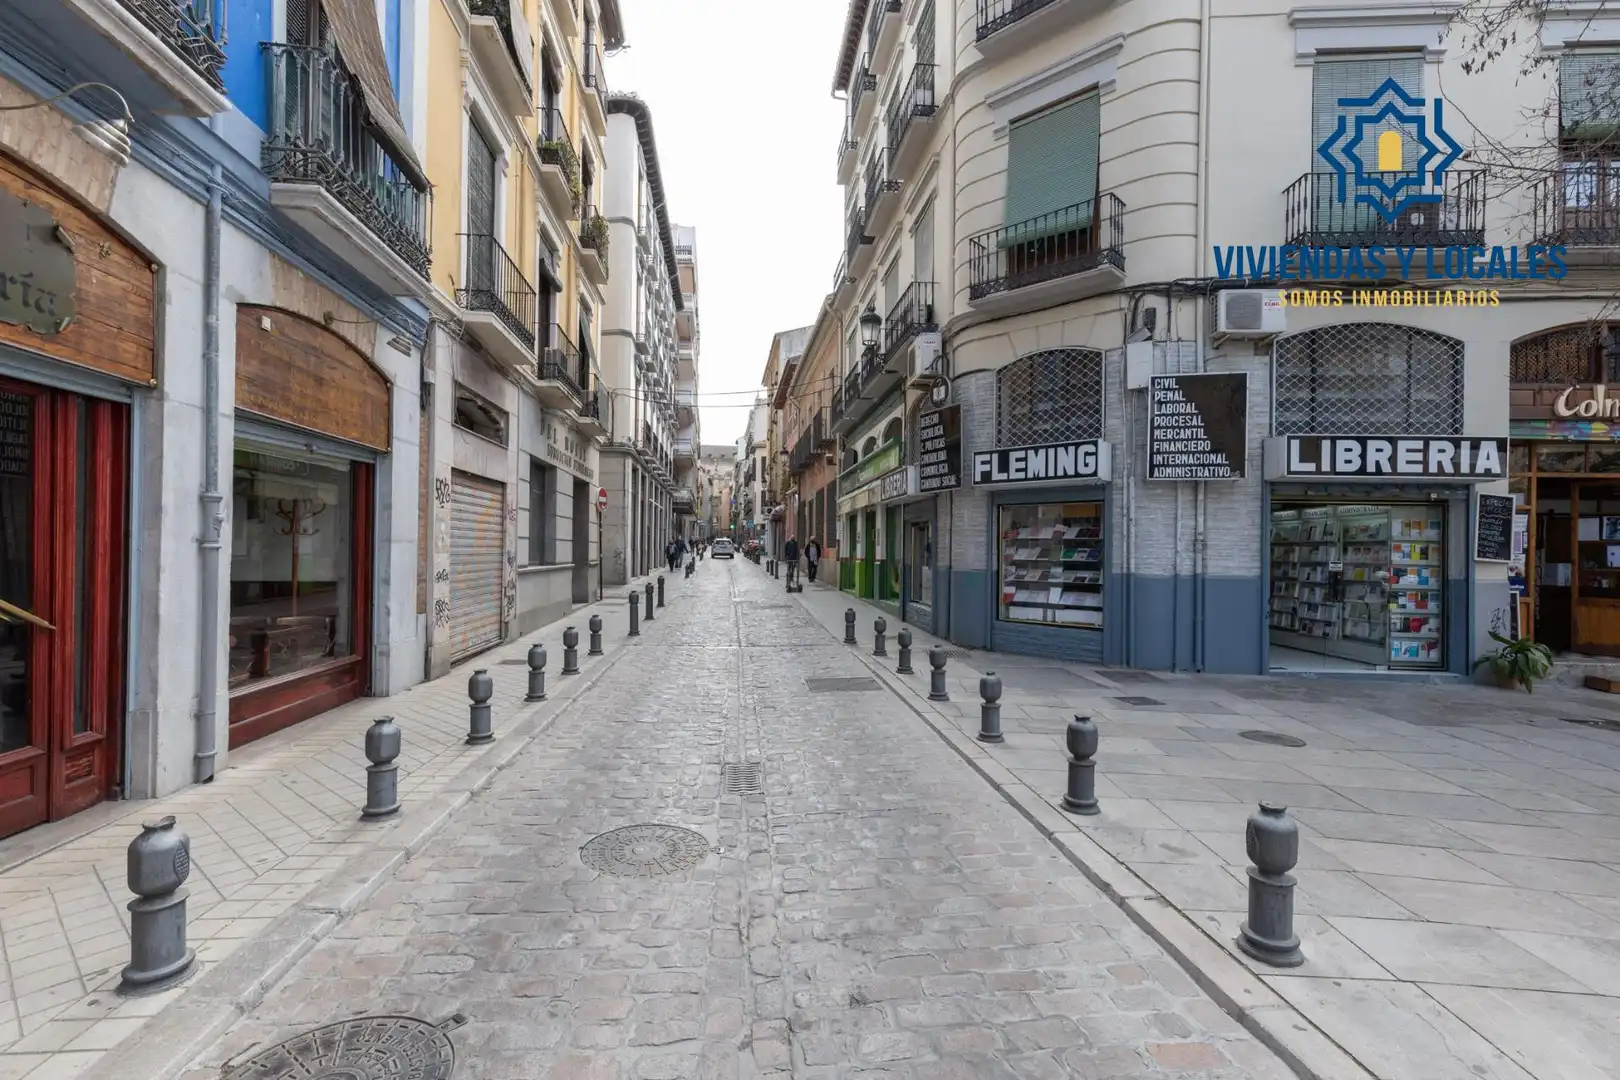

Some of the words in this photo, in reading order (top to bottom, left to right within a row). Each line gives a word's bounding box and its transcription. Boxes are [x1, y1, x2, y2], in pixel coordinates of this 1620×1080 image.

[1154, 378, 1179, 389] CIVIL
[1154, 390, 1186, 402] PENAL
[1154, 402, 1199, 414] LABORAL
[1154, 415, 1205, 427] PROCESAL
[1153, 428, 1208, 439] MERCANTIL
[1153, 440, 1211, 452] FINANCIERO
[1153, 453, 1229, 465] INTERNACIONAL
[1290, 439, 1501, 473] LIBRERIA
[975, 444, 1096, 482] FLEMING
[1153, 466, 1231, 478] ADMINISTRATIVO
[882, 470, 907, 500] LIBRERIA
